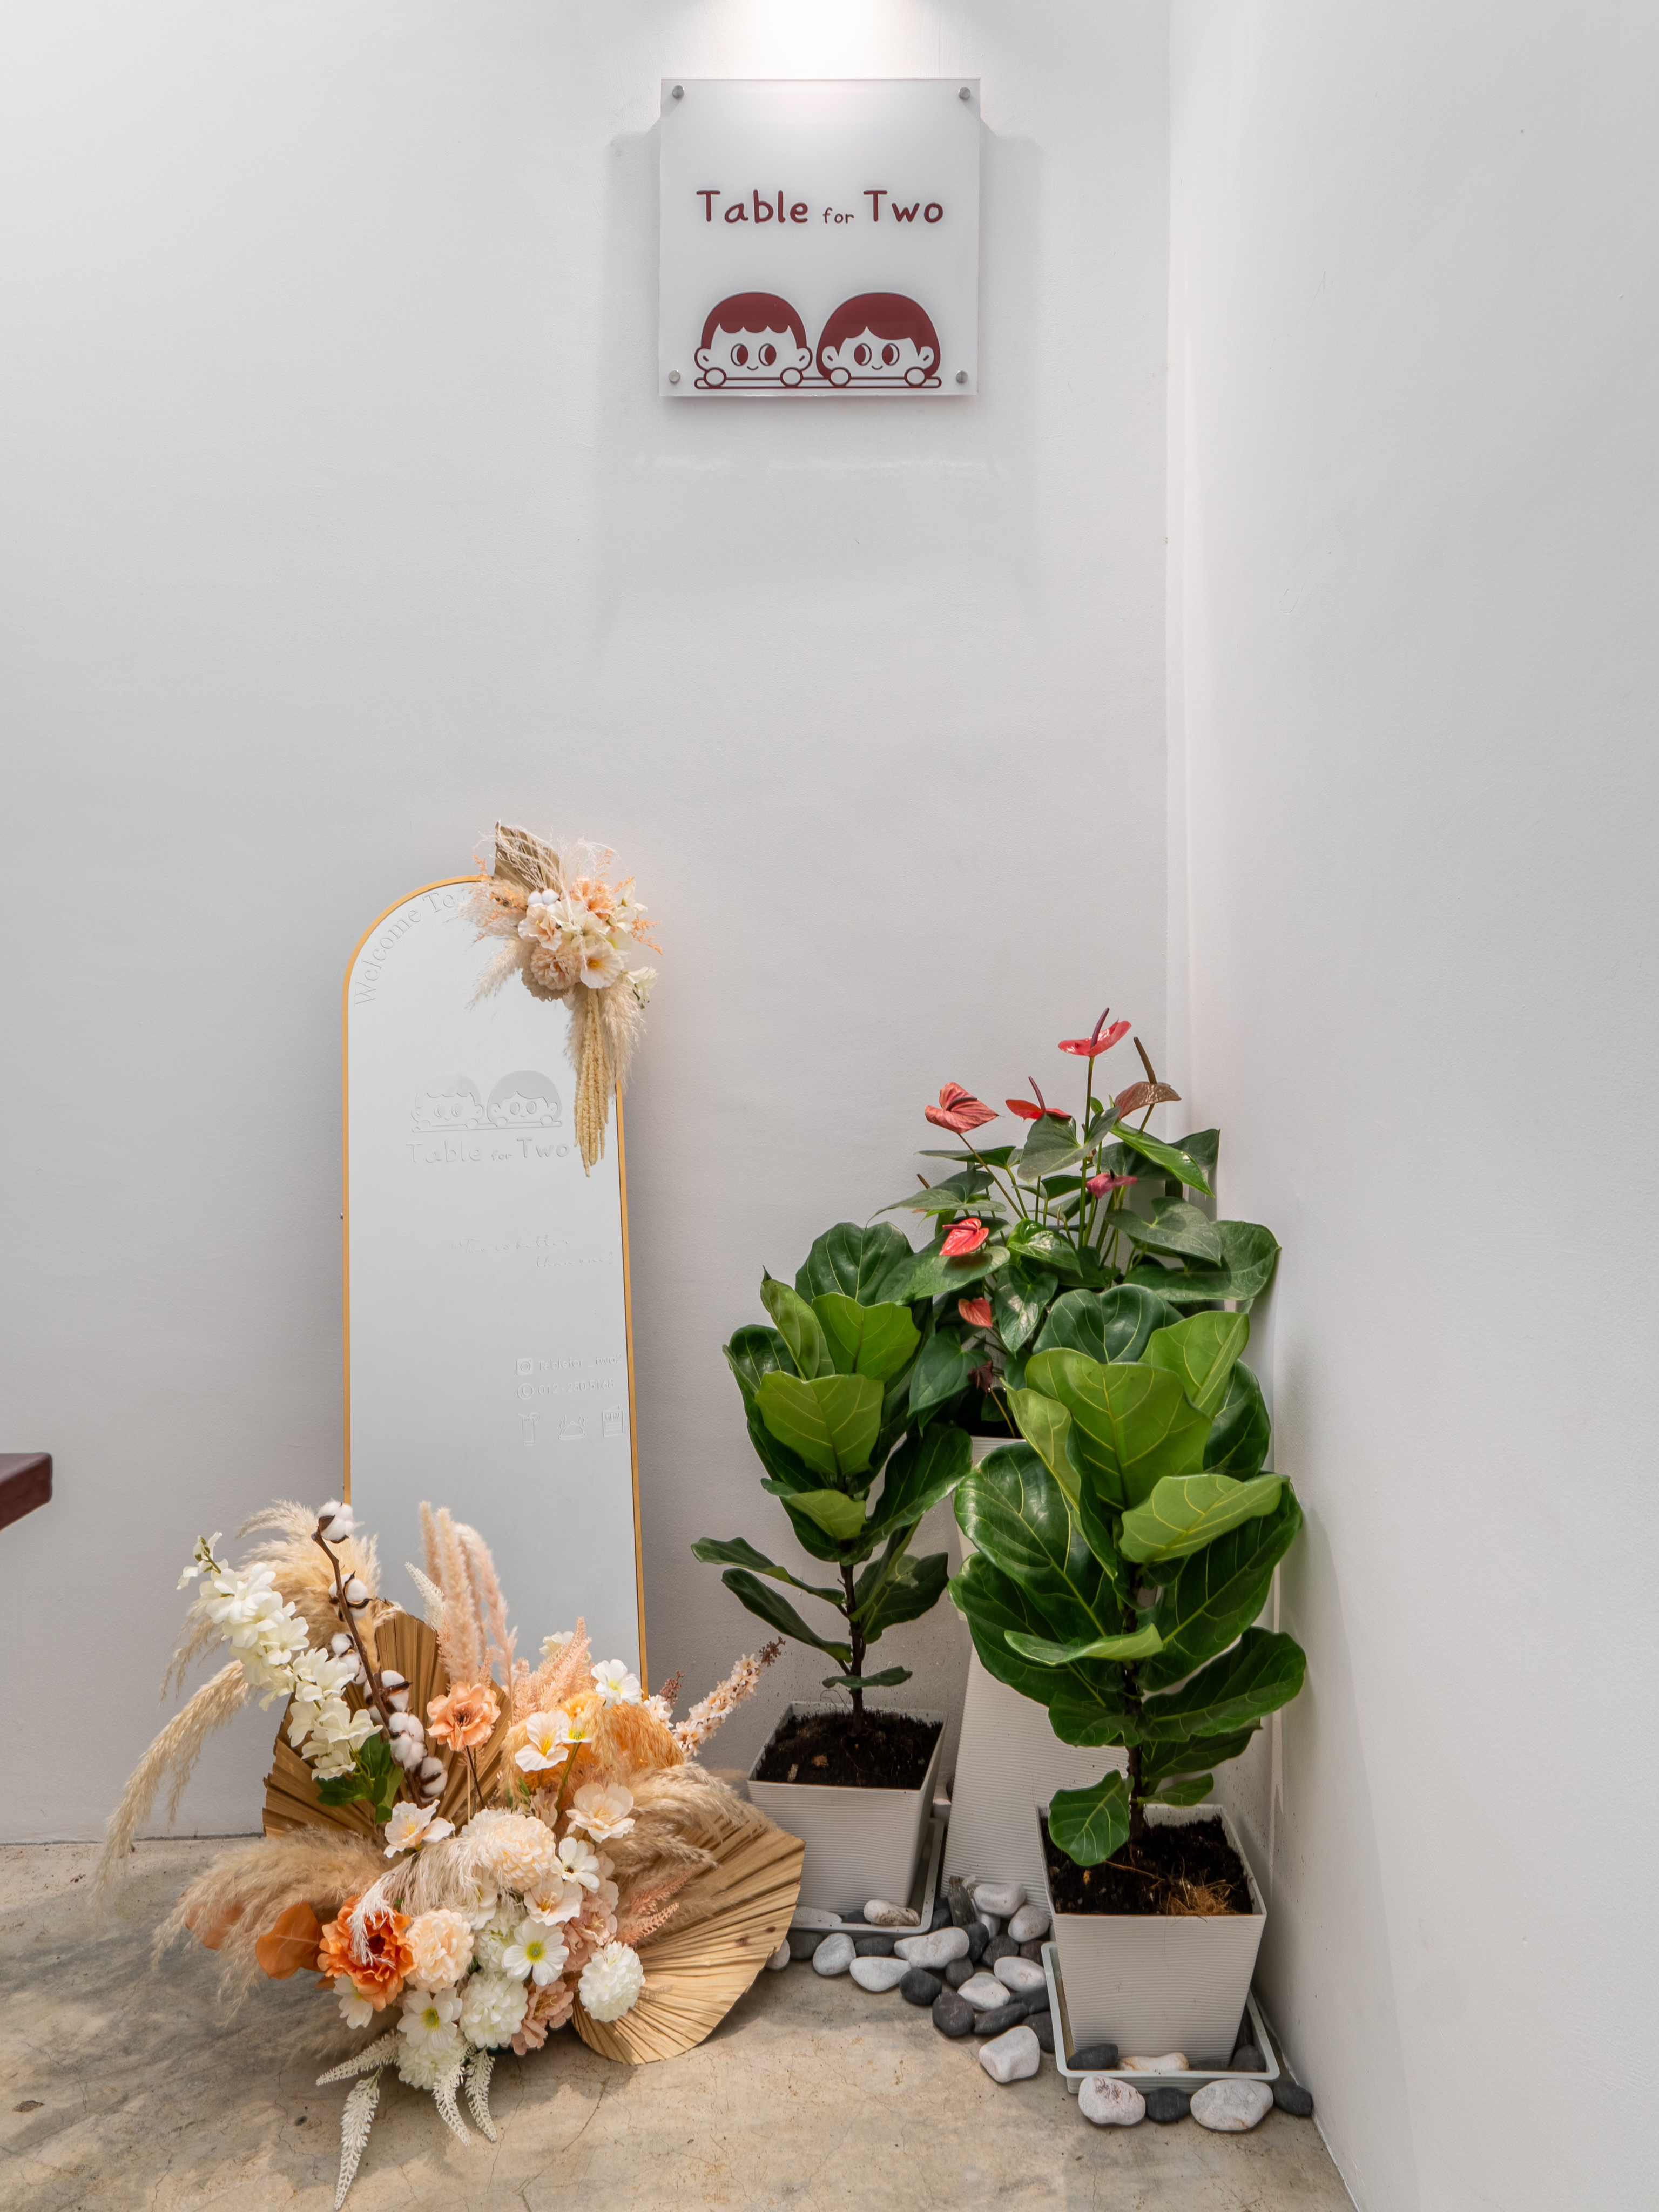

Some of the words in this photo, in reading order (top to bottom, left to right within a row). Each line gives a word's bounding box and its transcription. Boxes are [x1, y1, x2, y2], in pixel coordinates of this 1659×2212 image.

[696, 189, 808, 224] Table
[822, 207, 854, 224] for
[863, 190, 943, 224] Two
[354, 909, 421, 1006] Welcome
[422, 892, 456, 913] To
[406, 1139, 482, 1164] Table
[490, 1150, 512, 1162] for
[516, 1136, 570, 1158] Two
